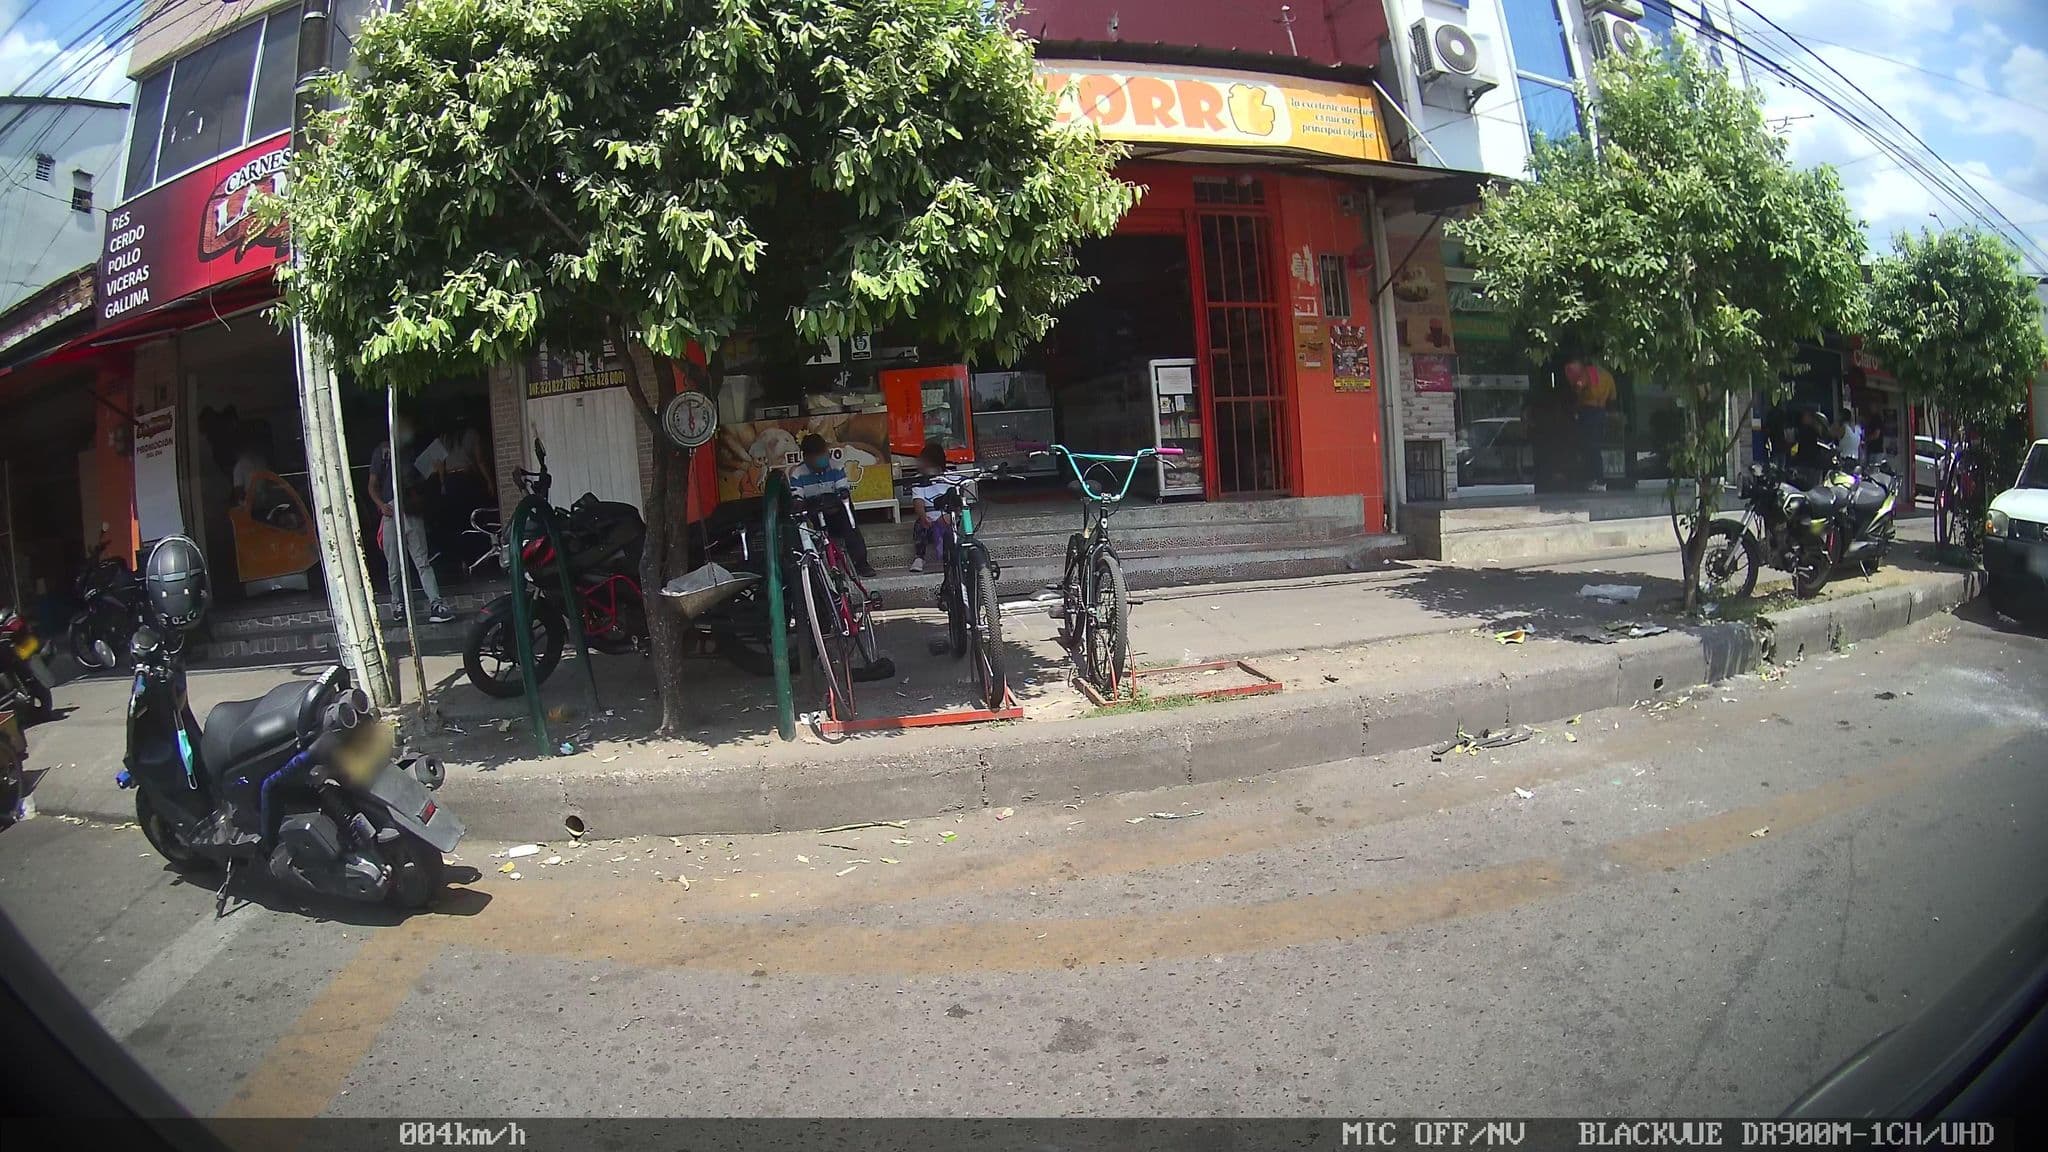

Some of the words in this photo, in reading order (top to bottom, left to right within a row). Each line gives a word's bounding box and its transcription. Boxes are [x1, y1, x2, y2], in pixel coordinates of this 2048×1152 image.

[225, 149, 291, 194] CARNES
[112, 211, 131, 232] RES
[110, 225, 145, 253] CERDO
[108, 248, 141, 276] POLLO
[106, 265, 149, 297] VICERAS
[105, 288, 149, 318] GALLINA
[786, 452, 802, 464] EL
